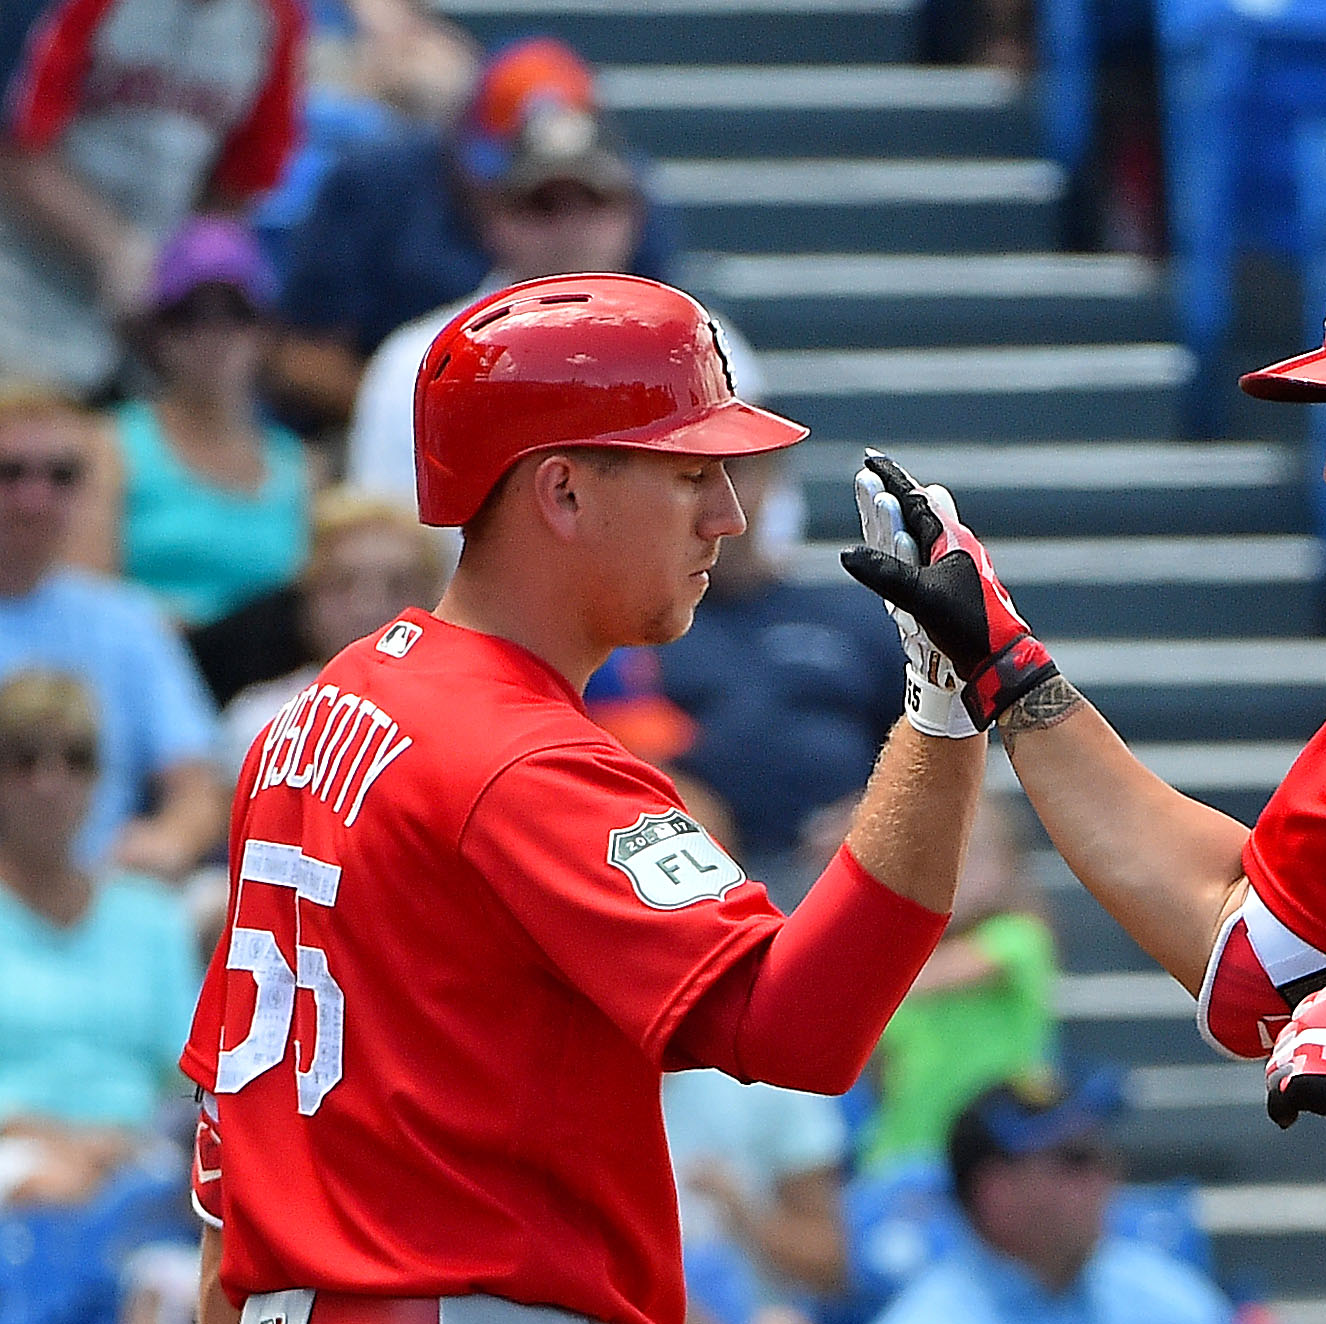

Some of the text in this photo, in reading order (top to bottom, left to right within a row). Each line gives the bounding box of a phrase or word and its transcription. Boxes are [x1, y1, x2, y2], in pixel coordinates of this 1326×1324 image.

[625, 836, 648, 853] 20
[655, 849, 719, 886] FL
[213, 838, 344, 1117] 55
